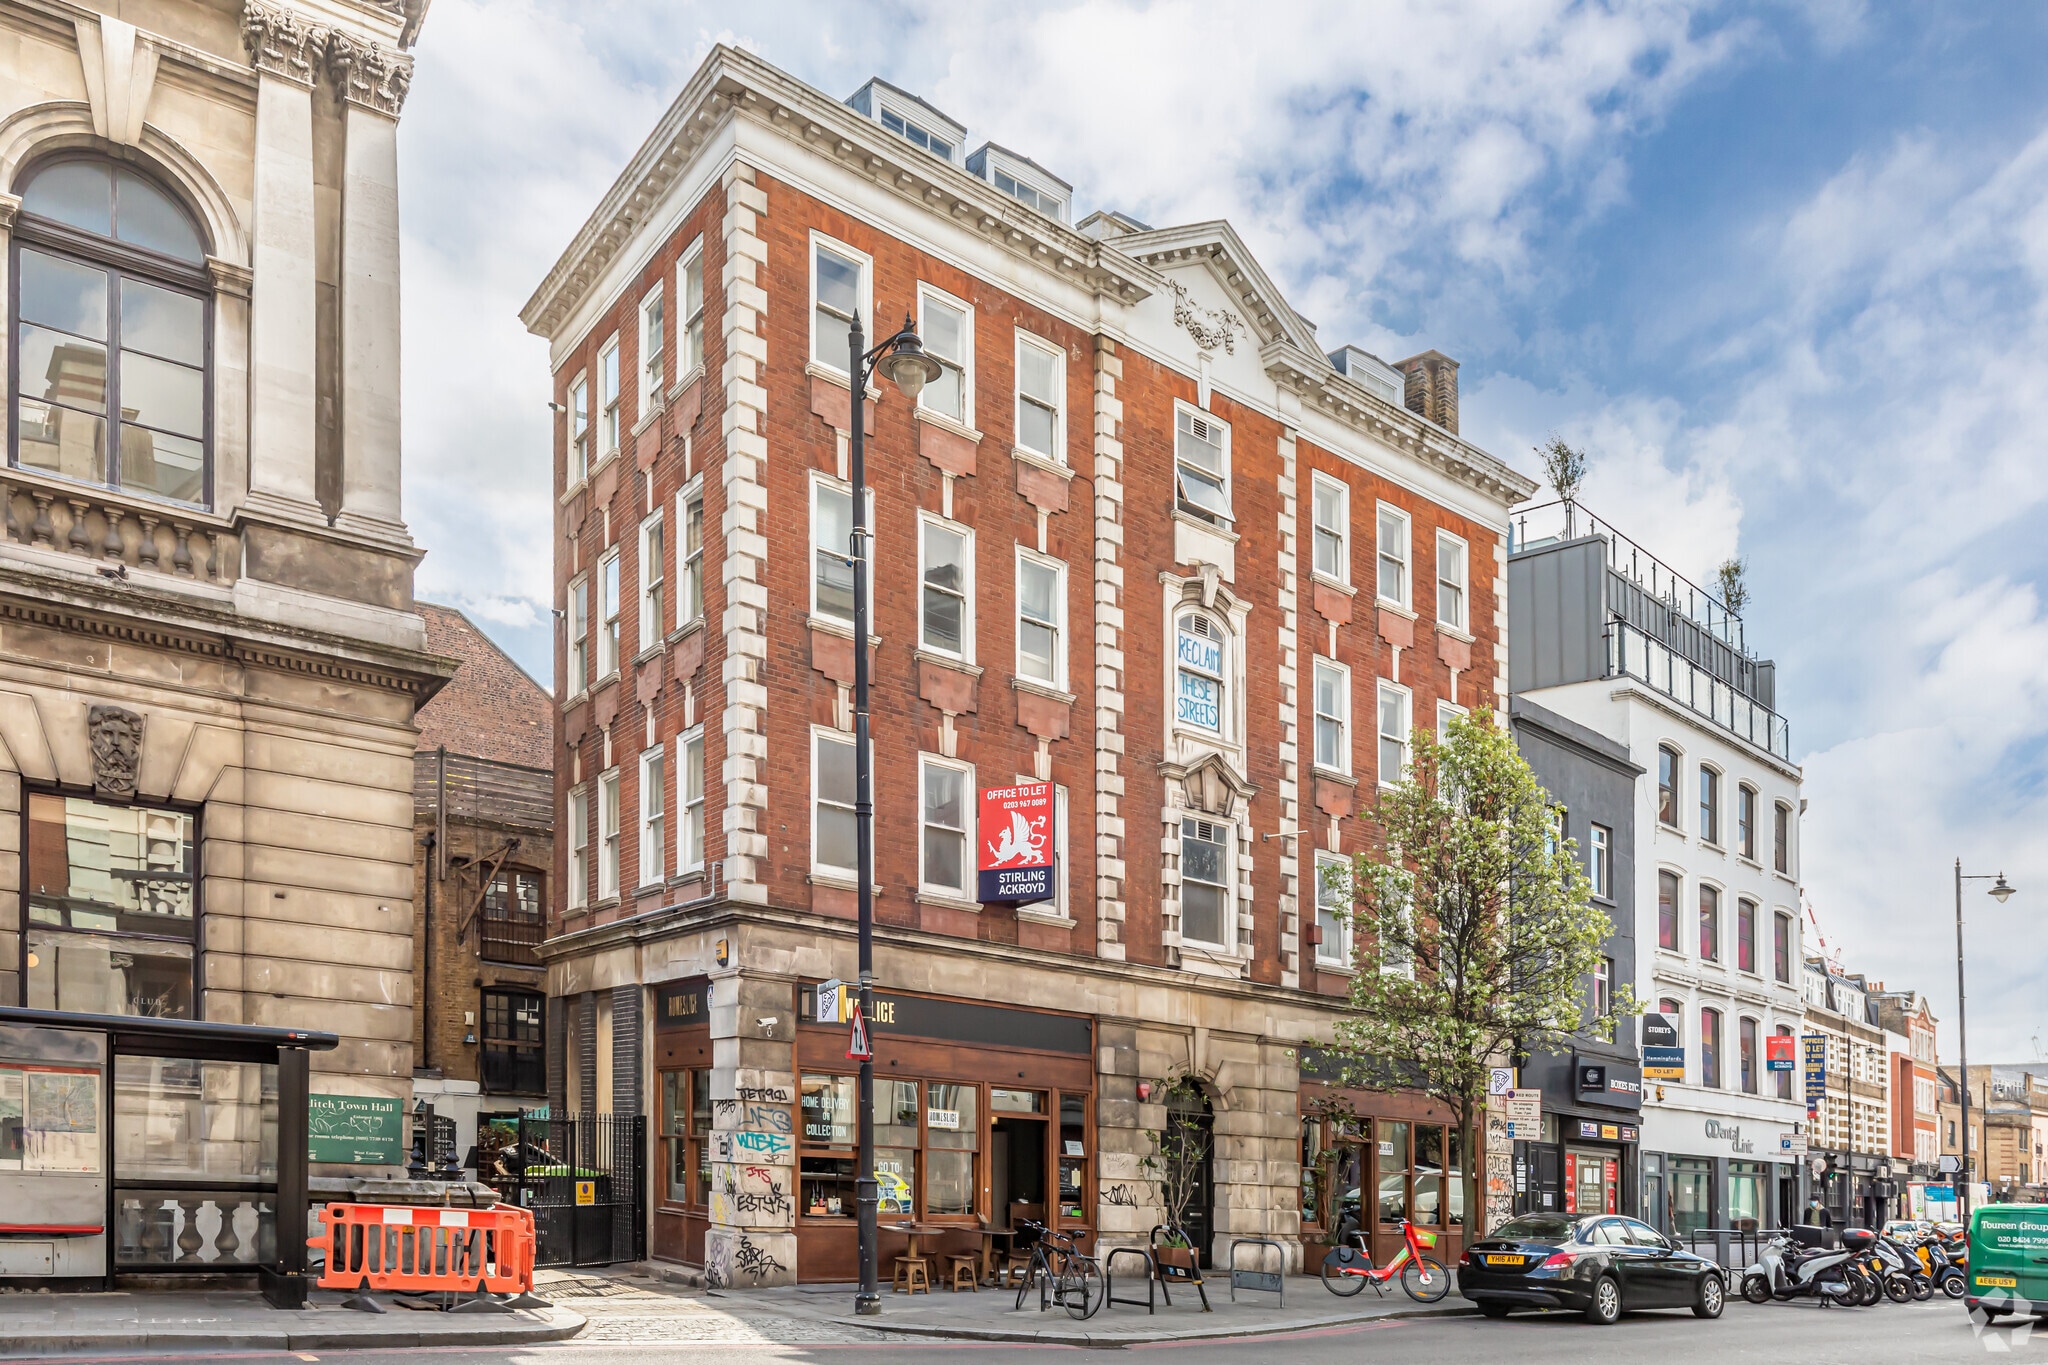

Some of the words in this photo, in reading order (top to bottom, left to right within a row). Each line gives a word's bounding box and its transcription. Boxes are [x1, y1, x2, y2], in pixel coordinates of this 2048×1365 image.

[1179, 636, 1219, 673] RECLAIM
[1180, 674, 1212, 702] THESE
[1178, 697, 1217, 726] STREETS
[987, 788, 1016, 800] OFFICE
[1018, 787, 1029, 797] TO
[1031, 785, 1046, 796] LET
[1003, 800, 1018, 809] 0203
[1020, 800, 1030, 808] 967
[999, 871, 1045, 883] STIRLING
[999, 883, 1045, 895] ACKROYD
[1610, 1080, 1627, 1090] BOXES
[338, 1101, 368, 1110] Town
[372, 1103, 392, 1111] Hall
[802, 1096, 818, 1108] HOME
[821, 1097, 849, 1110] DELIVERY
[929, 1112, 957, 1122] HOMESLICE
[806, 1124, 846, 1137] COLLECTION
[879, 1162, 888, 1172] GO
[1981, 1221, 2016, 1230] Toureen
[2020, 1222, 2048, 1232] Group
